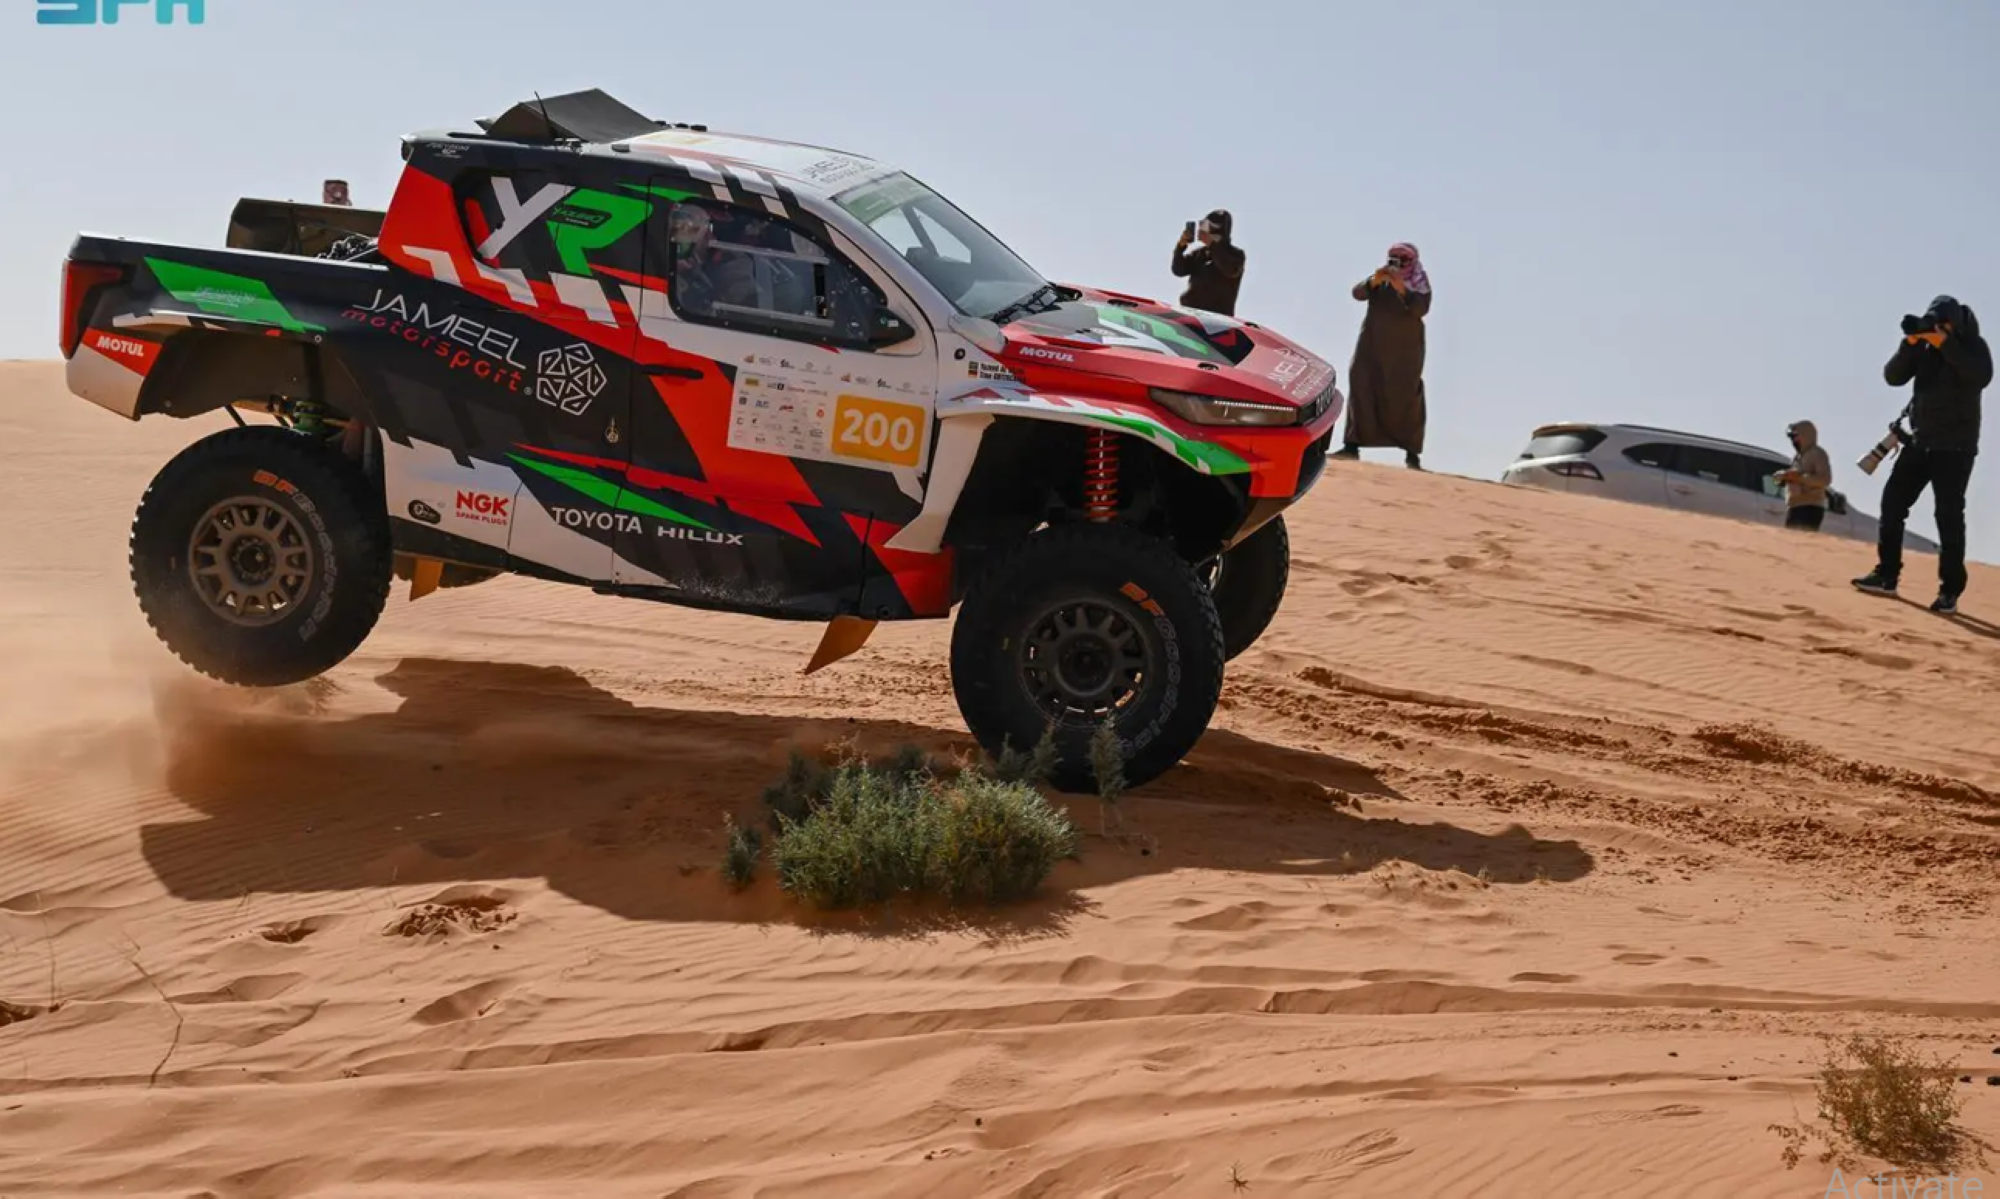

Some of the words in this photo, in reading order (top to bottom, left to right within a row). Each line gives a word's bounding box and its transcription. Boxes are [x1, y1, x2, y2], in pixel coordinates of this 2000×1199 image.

[352, 289, 526, 369] JAMEEL
[97, 335, 144, 357] MOTUL
[1019, 346, 1075, 362] MOTUL
[841, 408, 915, 452] 200
[456, 490, 509, 517] NGK
[456, 511, 480, 520] SPARK
[481, 515, 507, 526] PLUGS
[551, 506, 643, 534] TOYOTA
[657, 525, 744, 546] HILUX
